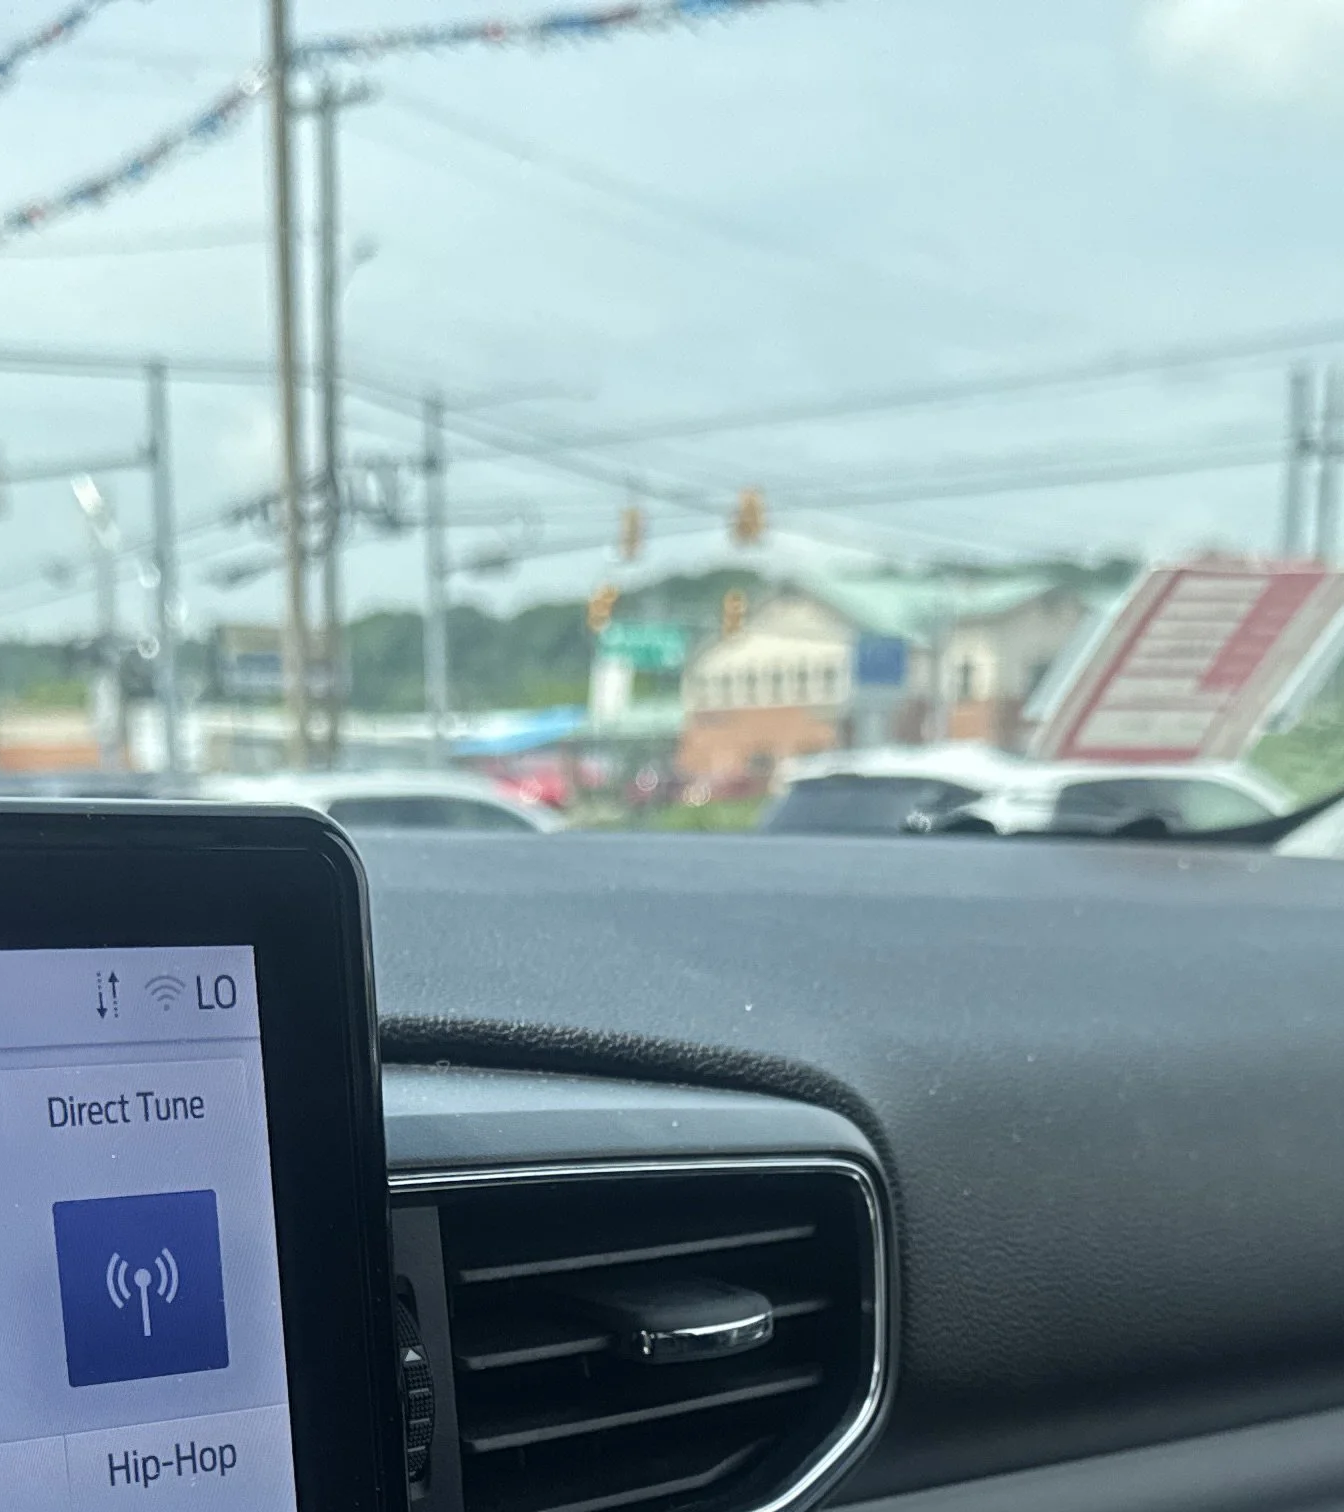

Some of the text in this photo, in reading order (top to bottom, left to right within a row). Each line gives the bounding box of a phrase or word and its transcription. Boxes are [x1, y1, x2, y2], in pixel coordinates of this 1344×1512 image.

[196, 974, 238, 1013] LO
[47, 1090, 206, 1129] Direct Tune
[106, 1440, 238, 1488] Hip-Hop
